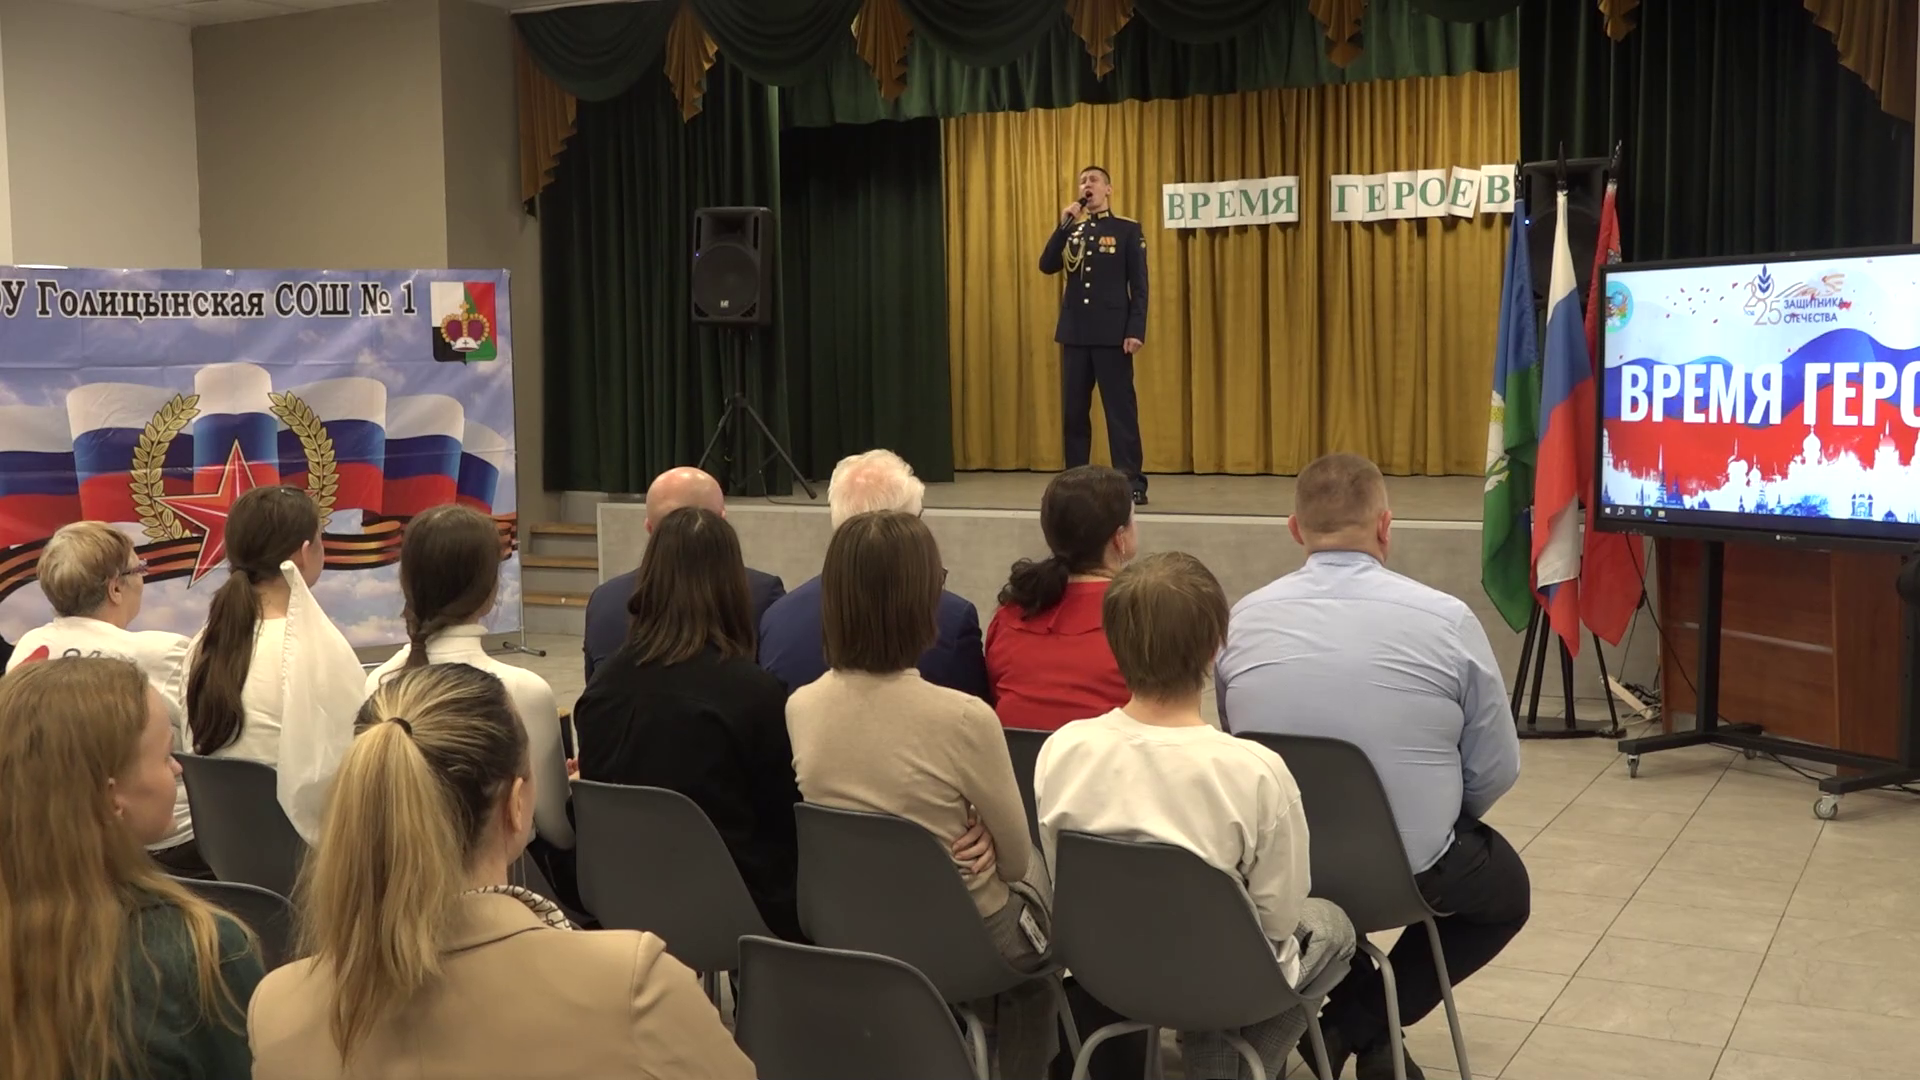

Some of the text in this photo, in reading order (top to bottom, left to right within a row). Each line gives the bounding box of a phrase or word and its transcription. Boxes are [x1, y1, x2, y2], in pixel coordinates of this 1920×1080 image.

[1167, 174, 1512, 221] ВРЕМЯ ГЕРОЕВ
[0, 279, 417, 322] У Голицынская СОШ № 1
[1783, 312, 1838, 324] ОТЕЧЕСТВА
[1620, 363, 1783, 425] ВРЕМЯ
